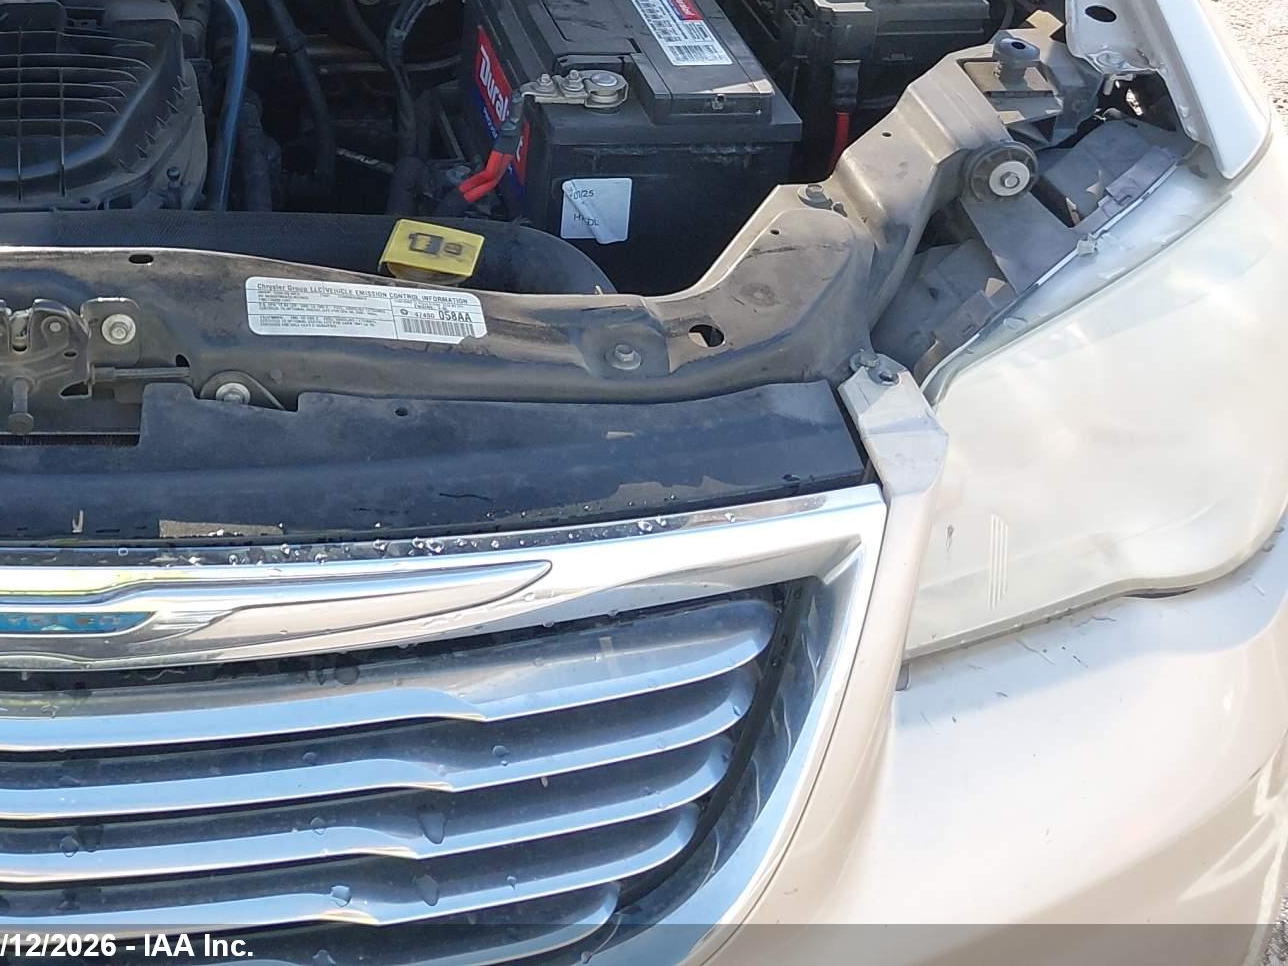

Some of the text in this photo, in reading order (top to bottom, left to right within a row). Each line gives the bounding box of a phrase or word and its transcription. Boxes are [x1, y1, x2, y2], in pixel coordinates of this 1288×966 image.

[257, 283, 286, 291] Chrysler
[287, 284, 308, 293] Group
[355, 289, 388, 298] EMISSION
[389, 292, 419, 301] CONTROL
[422, 295, 468, 304] INFORMATION
